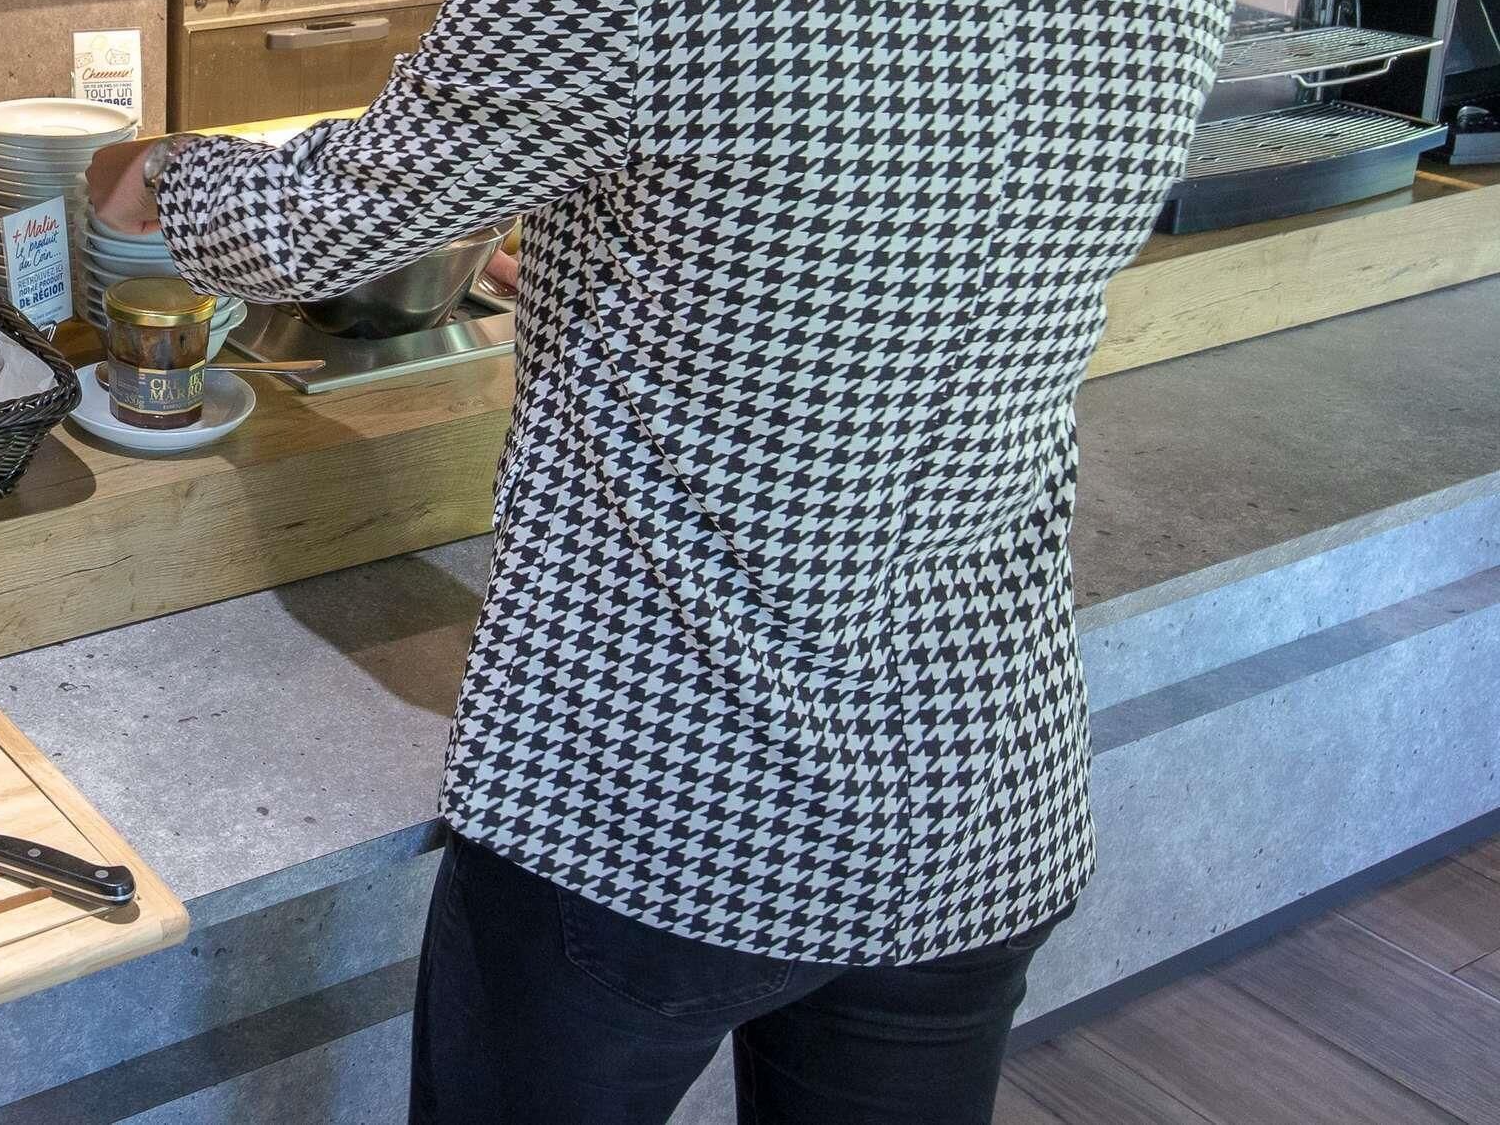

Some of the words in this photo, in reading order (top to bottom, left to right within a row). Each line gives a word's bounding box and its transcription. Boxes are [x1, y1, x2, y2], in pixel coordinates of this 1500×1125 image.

[84, 88, 113, 99] TOUT
[117, 88, 132, 97] UN
[24, 214, 59, 243] Malin
[28, 230, 59, 256] produit
[20, 298, 30, 309] DE
